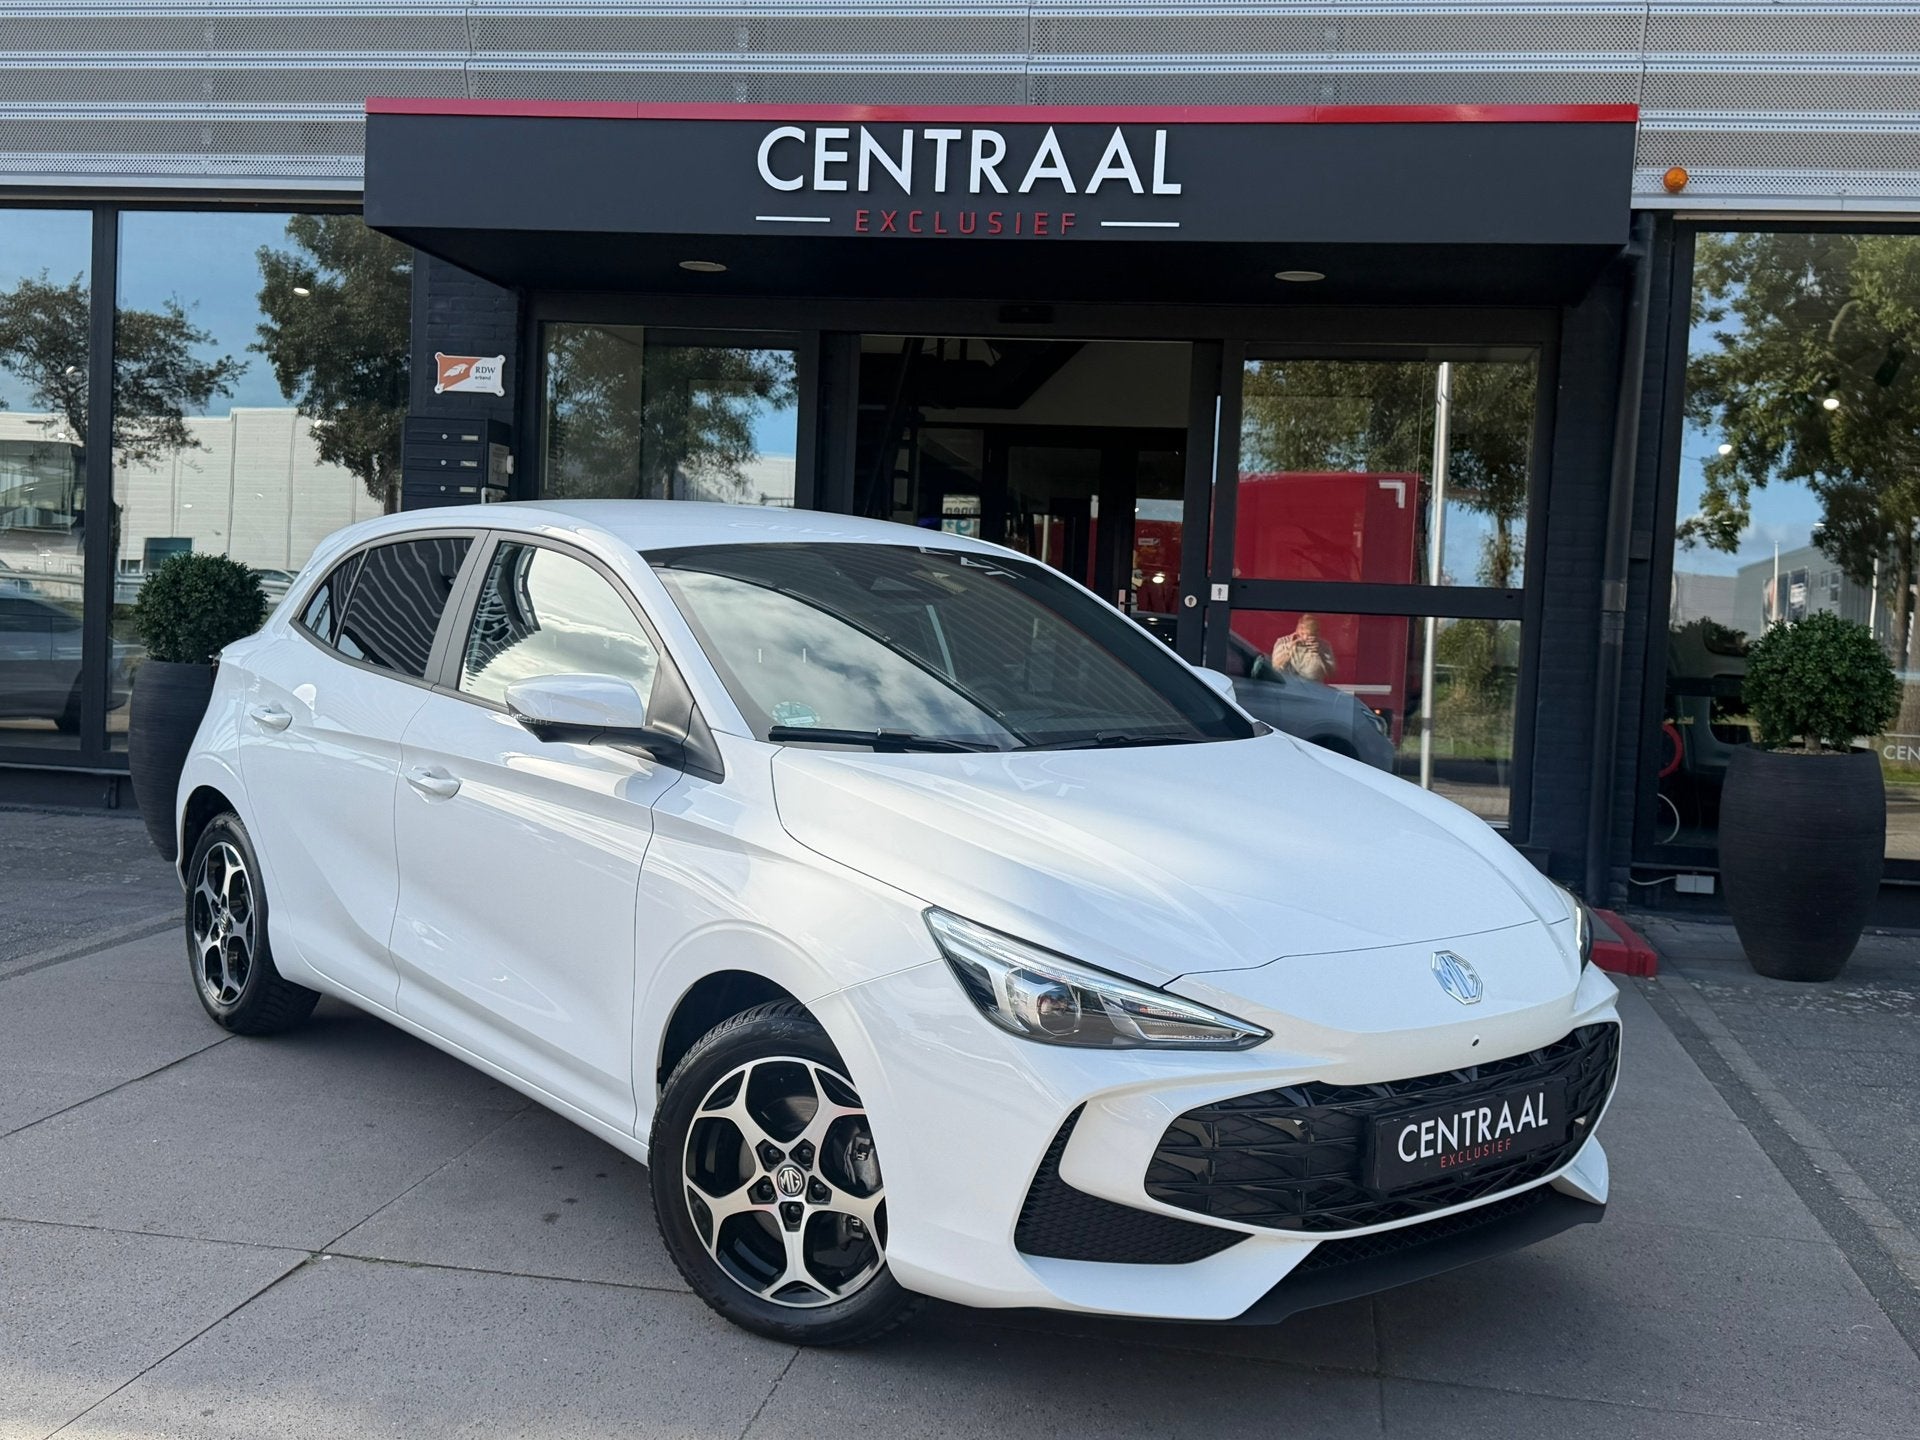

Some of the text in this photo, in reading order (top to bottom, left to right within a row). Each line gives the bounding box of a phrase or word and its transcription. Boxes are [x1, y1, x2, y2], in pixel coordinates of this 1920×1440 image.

[757, 125, 1182, 196] CENTRAAL
[854, 209, 1078, 235] EXCLUSIEF
[475, 366, 496, 374] RDW
[1435, 954, 1479, 1000] MG
[1398, 1092, 1548, 1162] CENTRAAL
[1440, 1138, 1512, 1168] EXCLUSIEF
[780, 1168, 801, 1193] MG
